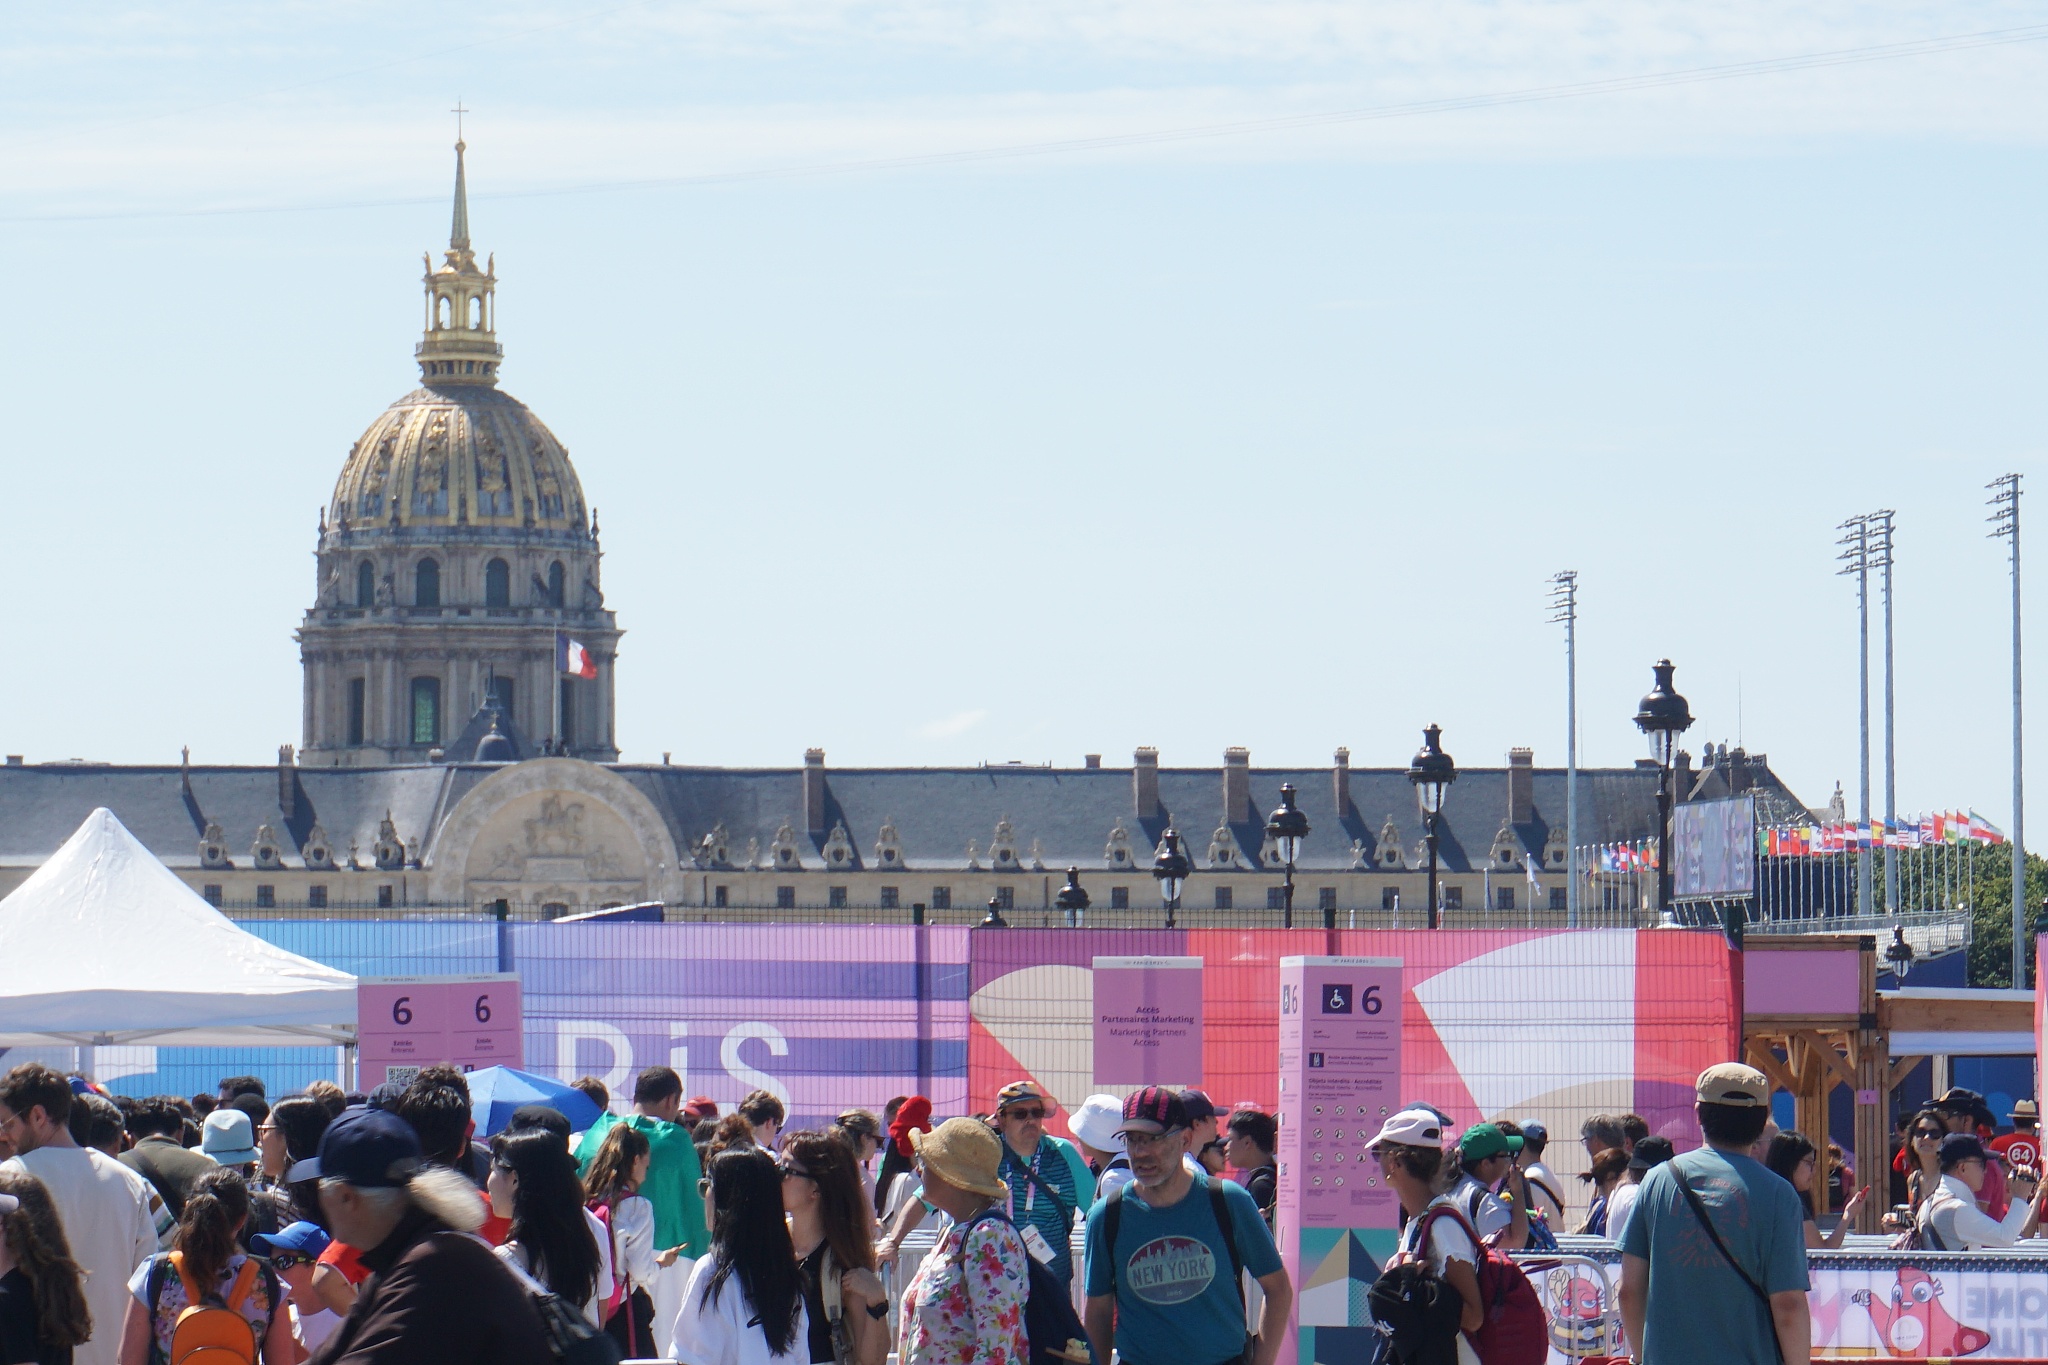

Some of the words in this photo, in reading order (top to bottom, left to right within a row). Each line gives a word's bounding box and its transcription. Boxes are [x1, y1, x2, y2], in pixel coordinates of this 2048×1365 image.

[475, 994, 491, 1023] 6
[1361, 985, 1383, 1015] 6
[393, 997, 413, 1025] 6
[1101, 1015, 1150, 1023] Partenaires
[1151, 1015, 1195, 1025] Marketing
[1109, 1028, 1151, 1038] Marketing
[1152, 1028, 1187, 1036] Partners
[1133, 1038, 1160, 1046] Access
[2011, 1148, 2030, 1162] 64
[1132, 1264, 1163, 1287] NEW
[1168, 1257, 1209, 1281] YORK
